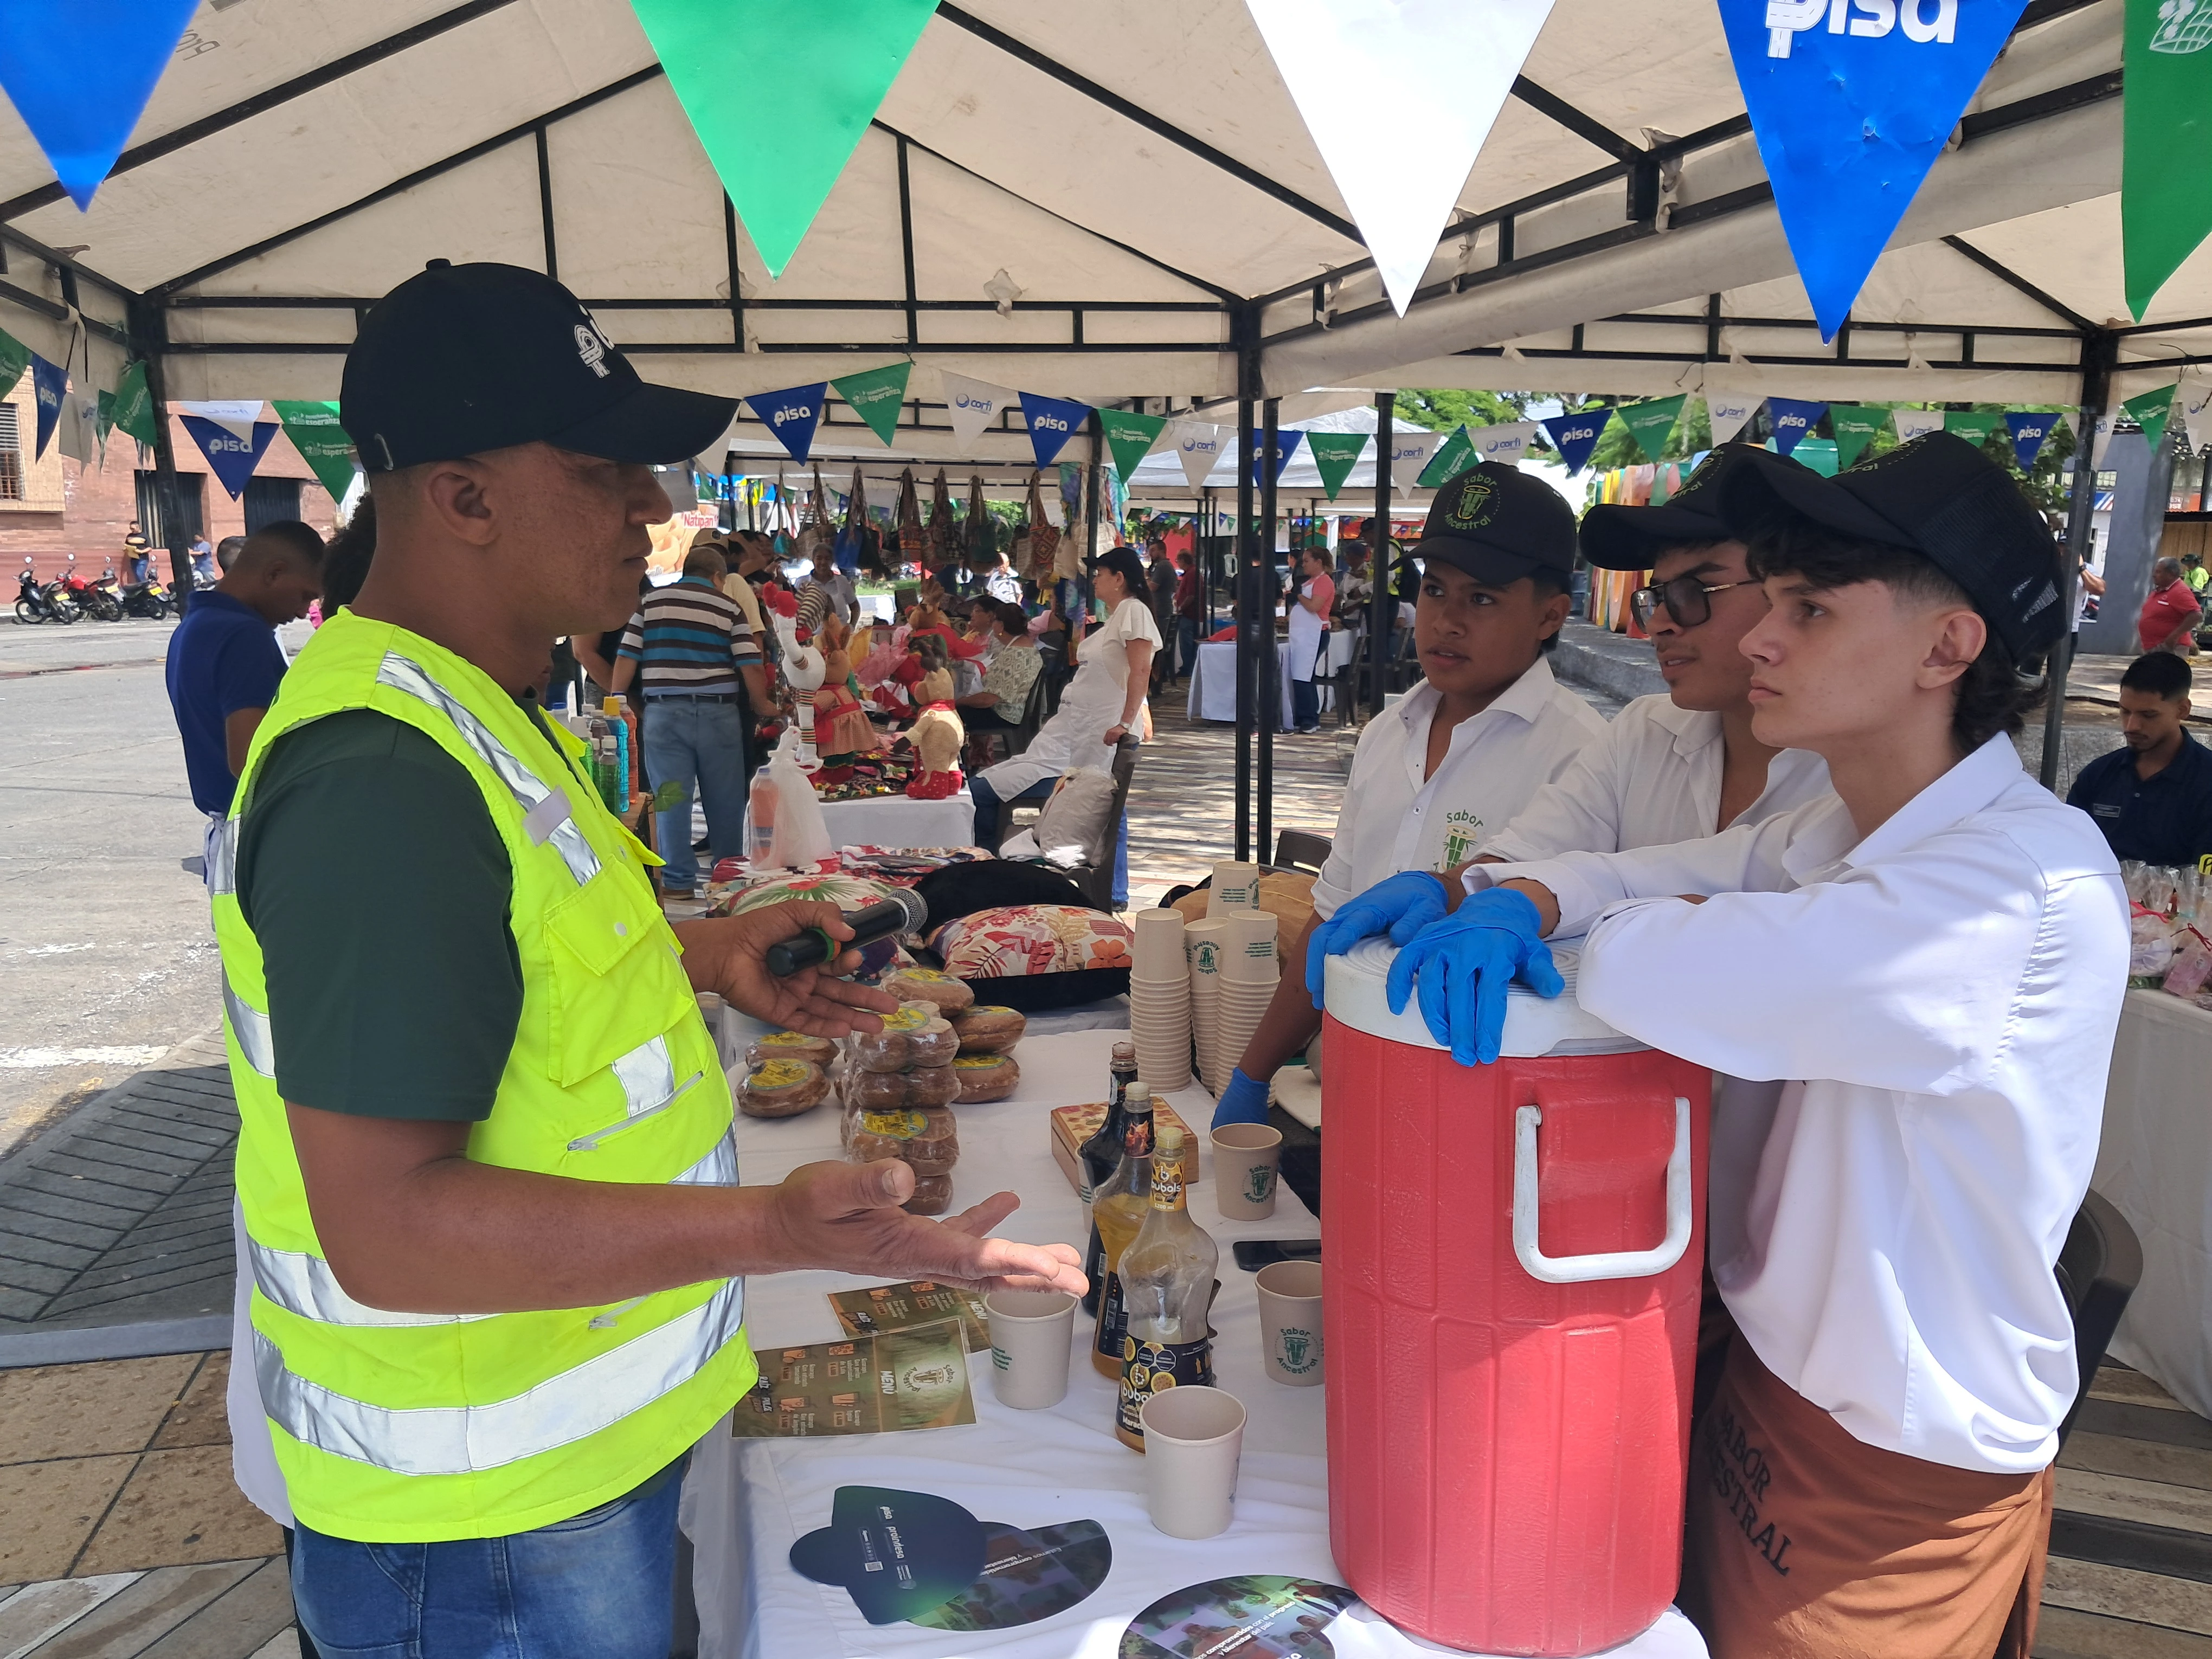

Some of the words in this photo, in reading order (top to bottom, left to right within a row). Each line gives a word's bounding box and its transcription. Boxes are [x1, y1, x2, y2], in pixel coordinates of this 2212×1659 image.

[970, 400, 993, 412] corfi
[774, 405, 811, 427] pisa
[1034, 413, 1069, 432] pisa
[1778, 413, 1807, 429] pisa
[1561, 427, 1594, 446] pisa
[2017, 425, 2042, 441] pisa
[209, 435, 253, 455] pisa
[1197, 440, 1217, 451] corfi
[1403, 446, 1424, 456] corfi
[1500, 438, 1521, 448] corfi
[1253, 447, 1284, 461] pa
[684, 513, 714, 529] Natipan
[1444, 513, 1491, 530] Ancestral
[1193, 941, 1220, 951] Ancestral
[1249, 1164, 1271, 1174] Sabor
[1151, 1178, 1181, 1193] bubols
[1280, 1327, 1311, 1337] Sabor
[1277, 1358, 1318, 1374] Ancestral
[880, 1370, 898, 1395] MENÚ
[903, 1366, 921, 1392] Ancestral
[1123, 1382, 1153, 1403] bubol
[879, 1506, 895, 1520] pisa
[886, 1526, 905, 1559] proindesa
[1206, 1625, 1254, 1655] comprometidos
[1252, 1618, 1263, 1627] con
[1269, 1602, 1296, 1618] progreso
[1221, 1634, 1252, 1653] bienestar
[1251, 1627, 1262, 1636] del
